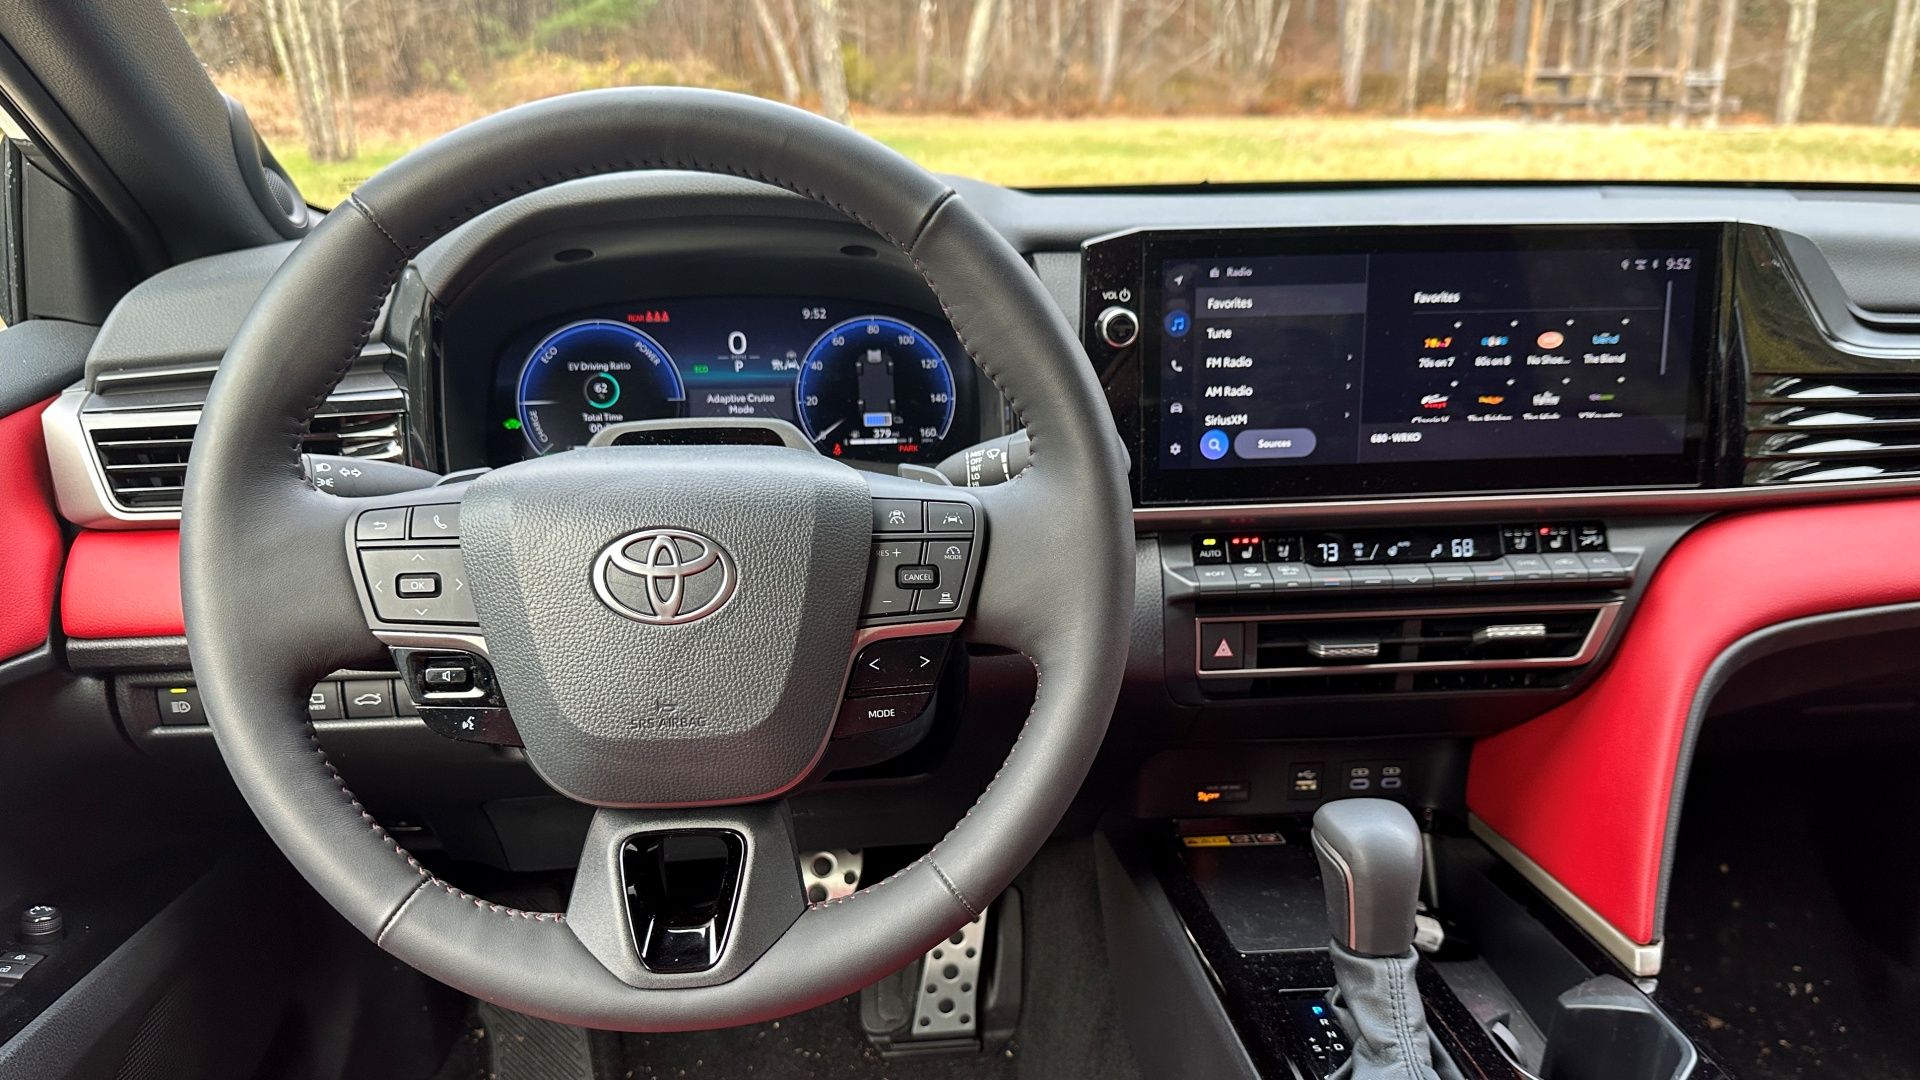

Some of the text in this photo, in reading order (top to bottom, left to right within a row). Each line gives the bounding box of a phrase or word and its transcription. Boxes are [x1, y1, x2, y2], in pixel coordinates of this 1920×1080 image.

[1666, 258, 1691, 270] 9:52
[1226, 266, 1253, 278] Radio
[1102, 291, 1118, 300] VOL
[1413, 291, 1461, 304] Favorites
[1207, 297, 1253, 310] Favorites
[803, 308, 827, 320] 9:52
[867, 325, 880, 335] 80
[1206, 327, 1232, 339] Tune
[728, 331, 747, 355] 0
[831, 337, 845, 346] 60
[898, 336, 915, 346] 100
[540, 346, 558, 364] ECO
[634, 341, 661, 366] POWER
[568, 361, 632, 372] EV Driving Ratio
[734, 360, 744, 373] P
[811, 361, 823, 370] 40
[922, 359, 938, 369] 120
[1206, 355, 1253, 369] FM Radio
[693, 365, 709, 374] ECO
[593, 383, 608, 393] 62
[1204, 385, 1253, 398] AM Radio
[707, 393, 775, 405] Adaptive Cruise
[806, 396, 818, 406] 20
[930, 394, 948, 403] 140
[728, 405, 755, 414] Mode
[582, 412, 624, 421] Total Time
[1204, 414, 1248, 427] SiriusXM
[873, 428, 891, 438] 379
[920, 427, 937, 437] 160
[899, 444, 919, 452] PARK
[1257, 438, 1291, 448] Sources
[970, 472, 980, 480] LO
[1317, 543, 1339, 562] 73
[1451, 538, 1473, 557] 68
[904, 573, 932, 581] CANCEL
[410, 581, 425, 590] OK
[868, 709, 895, 718] MODE
[658, 717, 707, 730] AIRBAG
[1333, 1043, 1345, 1051] D
